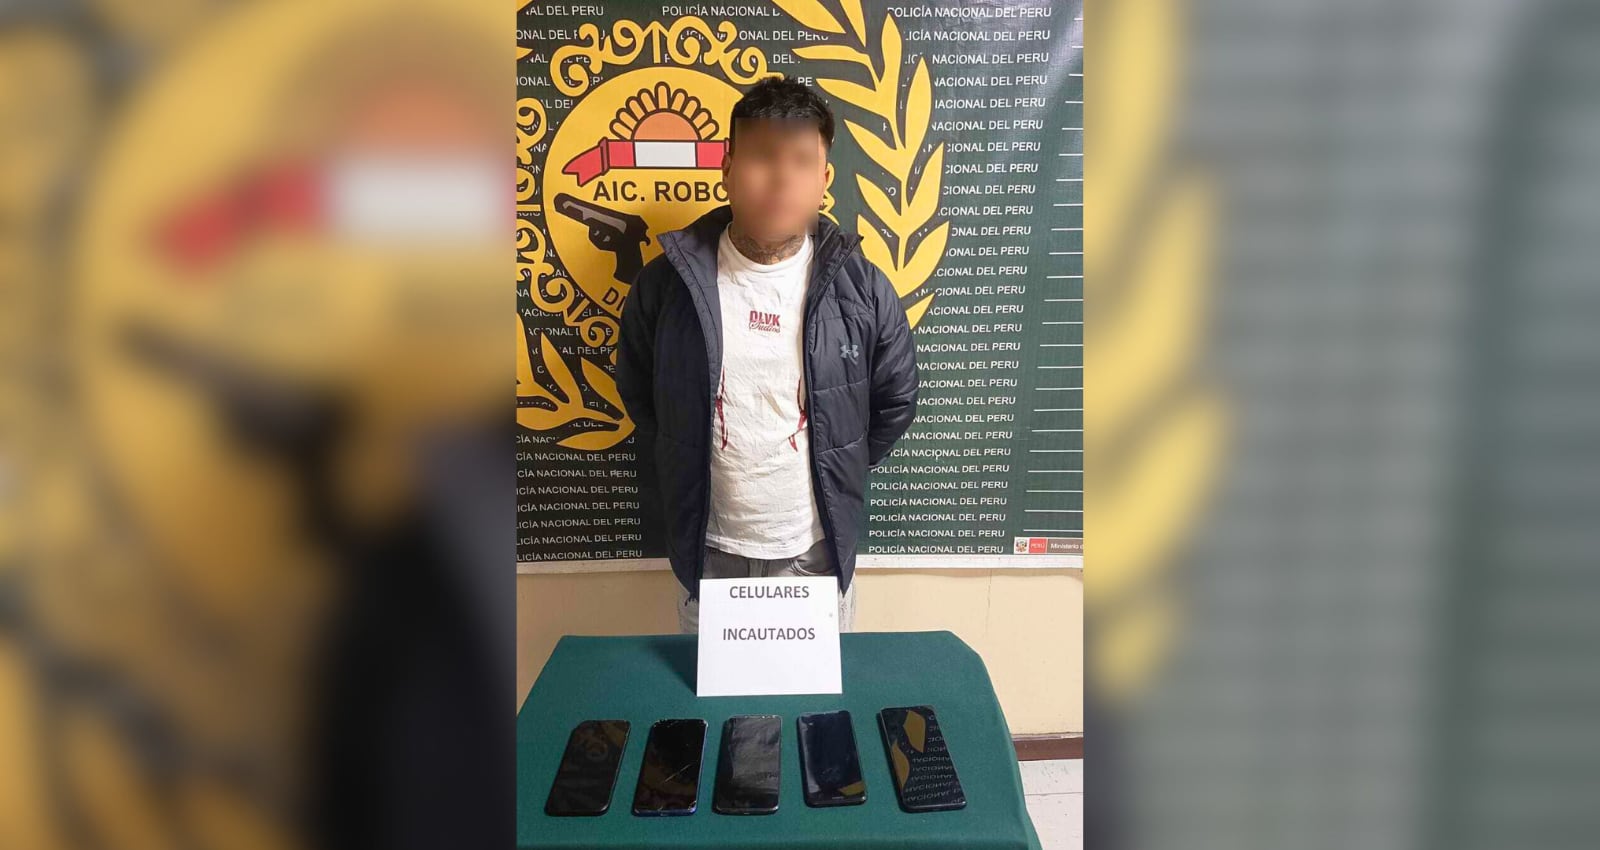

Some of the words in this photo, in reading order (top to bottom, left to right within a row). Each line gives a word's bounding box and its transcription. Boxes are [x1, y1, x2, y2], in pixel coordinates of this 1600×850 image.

[547, 6, 568, 15] DEL
[572, 6, 603, 15] PERU
[711, 6, 769, 16] NACIONAL
[934, 8, 993, 17] NACIONAL
[995, 8, 1018, 17] DEL
[1019, 8, 1051, 17] PERU
[549, 30, 571, 39] DEL
[773, 31, 794, 40] DEL
[934, 31, 990, 41] NACIONAL
[994, 31, 1015, 41] DEL
[1018, 30, 1050, 40] PERU
[773, 54, 795, 63] DEL
[932, 53, 989, 64] NACIONAL
[992, 54, 1014, 64] DEL
[1017, 53, 1048, 63] PERU
[991, 77, 1012, 86] DEL
[1016, 75, 1047, 85] PERU
[990, 99, 1011, 108] DEL
[1015, 98, 1045, 107] PERU
[989, 120, 1010, 129] DEL
[1014, 120, 1043, 129] PERU
[988, 142, 1009, 151] DEL
[1012, 142, 1040, 151] PERU
[987, 164, 1007, 172] DEL
[1010, 164, 1038, 172] PERU
[594, 181, 645, 201] AIC.
[985, 185, 1005, 194] DEL
[1008, 185, 1035, 193] PERU
[983, 206, 1002, 215] DEL
[1005, 206, 1033, 214] PERU
[981, 227, 1000, 235] DEL
[1003, 226, 1031, 235] PERU
[979, 247, 998, 255] DEL
[1001, 247, 1029, 255] PERU
[977, 267, 996, 275] DEL
[999, 266, 1027, 275] PERU
[975, 286, 994, 294] DEL
[997, 286, 1025, 294] PERU
[928, 305, 970, 316] ACIONAL
[973, 306, 993, 314] DEL
[996, 305, 1023, 313] PERU
[750, 311, 780, 326] DLVK
[918, 325, 969, 334] NACIONAL
[994, 324, 1022, 332] PERU
[917, 344, 968, 352] NACIONAL
[971, 343, 989, 351] DEL
[917, 362, 966, 370] NACIONAL
[968, 379, 986, 387] DEL
[913, 415, 962, 423] NACIONAL
[987, 414, 1014, 422] PERU
[986, 431, 1012, 439] PERU
[535, 453, 584, 461] NACIONAL
[912, 448, 961, 458] NACIONAL
[538, 486, 588, 494] NACIONAL
[871, 482, 908, 490] POLICÍA
[910, 482, 958, 490] NACIONAL
[871, 498, 907, 506] POLICÍA
[518, 503, 537, 512] ICÍA
[540, 503, 590, 511] NACIONAL
[541, 519, 591, 527] NACIONAL
[869, 529, 906, 537] POLICÍA
[542, 536, 592, 544] NACIONAL
[869, 545, 905, 553] POLICÍA
[517, 553, 541, 561] LICÍA
[730, 586, 809, 598] CELULARES
[723, 628, 815, 640] INCAUTADOS
